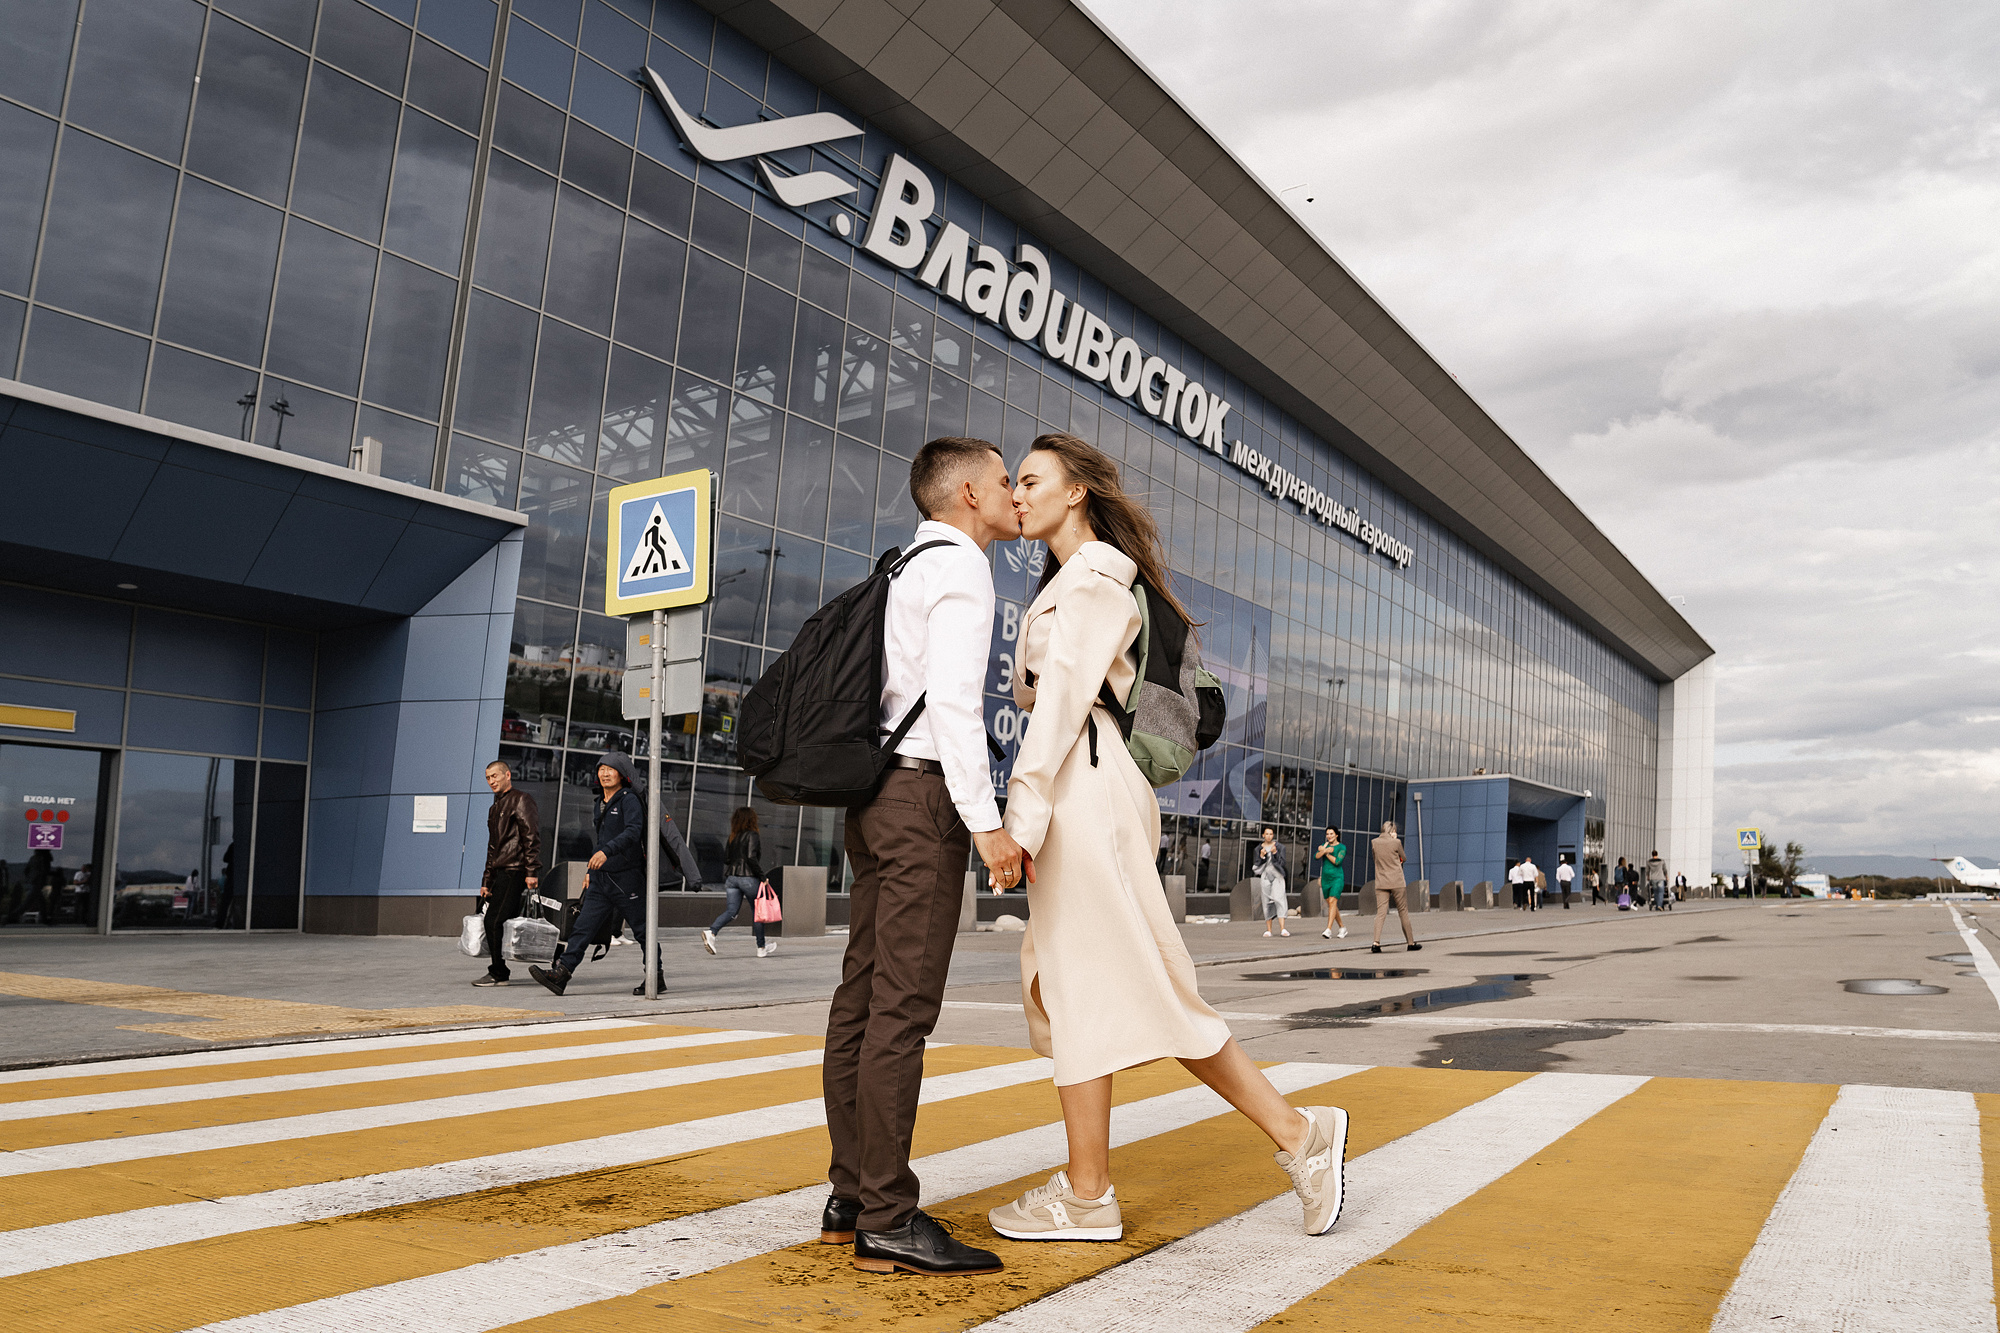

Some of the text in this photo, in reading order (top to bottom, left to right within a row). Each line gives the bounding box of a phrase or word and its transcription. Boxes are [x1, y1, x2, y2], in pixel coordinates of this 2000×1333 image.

[862, 153, 1231, 455] Владивосток
[1231, 439, 1414, 570] международный аэропорт
[23, 795, 76, 805] ВХОДА НЕТ
